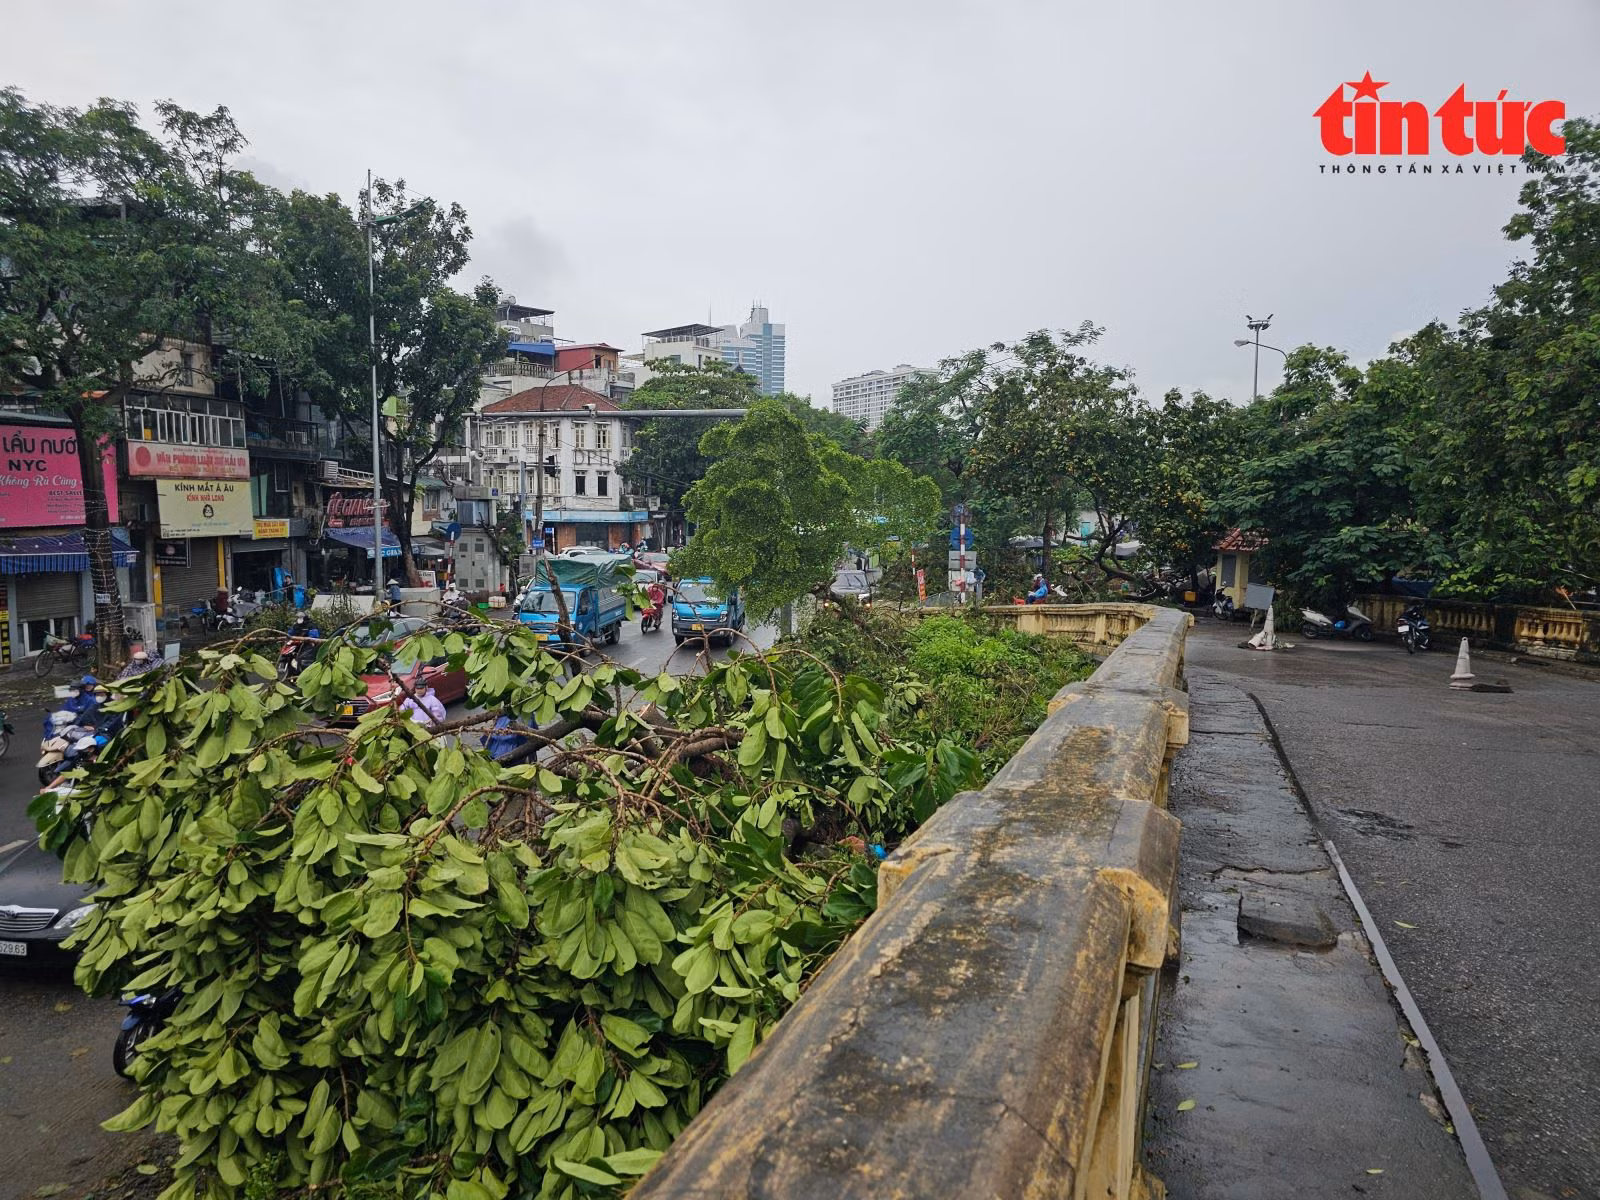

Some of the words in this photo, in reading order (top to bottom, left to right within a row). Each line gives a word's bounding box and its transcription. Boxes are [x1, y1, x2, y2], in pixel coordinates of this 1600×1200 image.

[3, 431, 36, 454] LẨU
[41, 437, 77, 455] NƯỚ
[8, 459, 48, 472] NYC
[174, 482, 195, 492] KÍNH
[198, 482, 214, 492] MẮT
